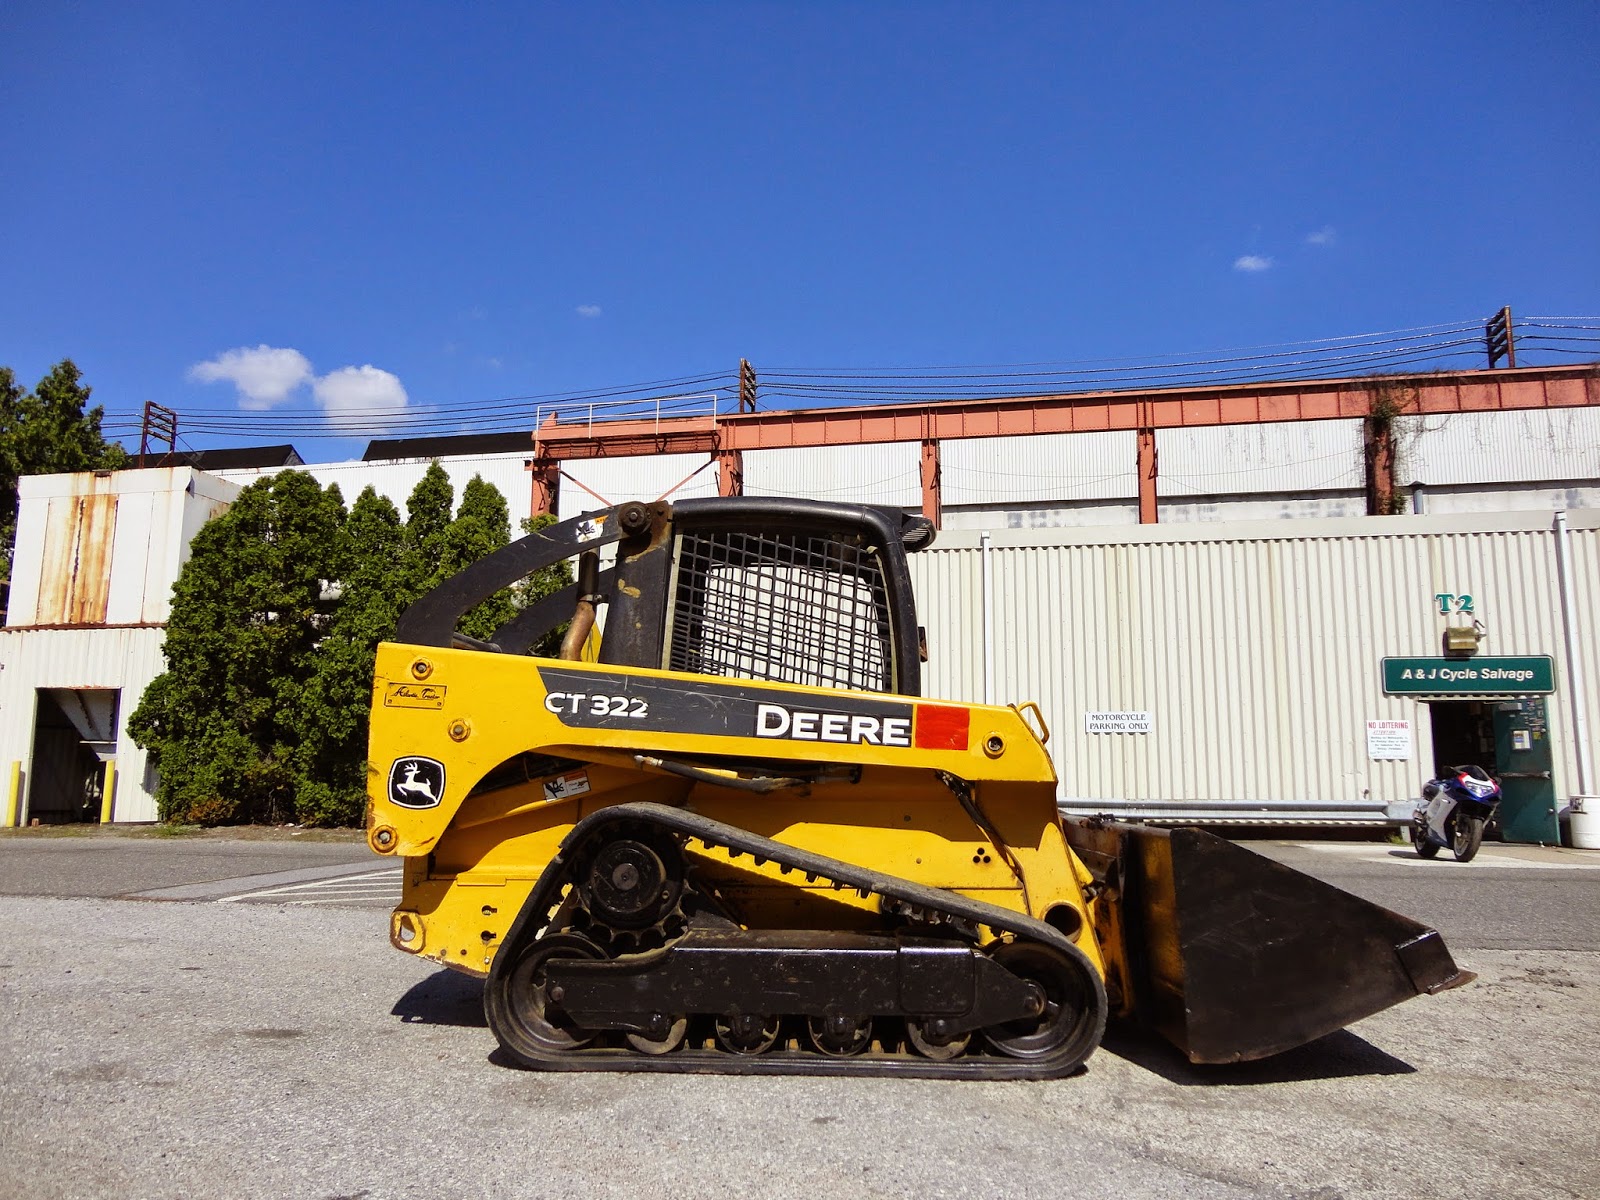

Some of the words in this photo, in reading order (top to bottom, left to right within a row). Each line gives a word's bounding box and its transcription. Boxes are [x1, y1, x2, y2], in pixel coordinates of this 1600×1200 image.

[1402, 669, 1412, 679] A
[1415, 669, 1425, 679] &
[1428, 669, 1436, 679] J
[1440, 668, 1477, 681] Cycle
[1481, 668, 1534, 681] Salvage
[545, 692, 586, 714] CT
[590, 694, 649, 718] 322
[756, 704, 910, 746] DEERE
[1089, 722, 1125, 730] PARKING
[1128, 722, 1150, 730] ONLY
